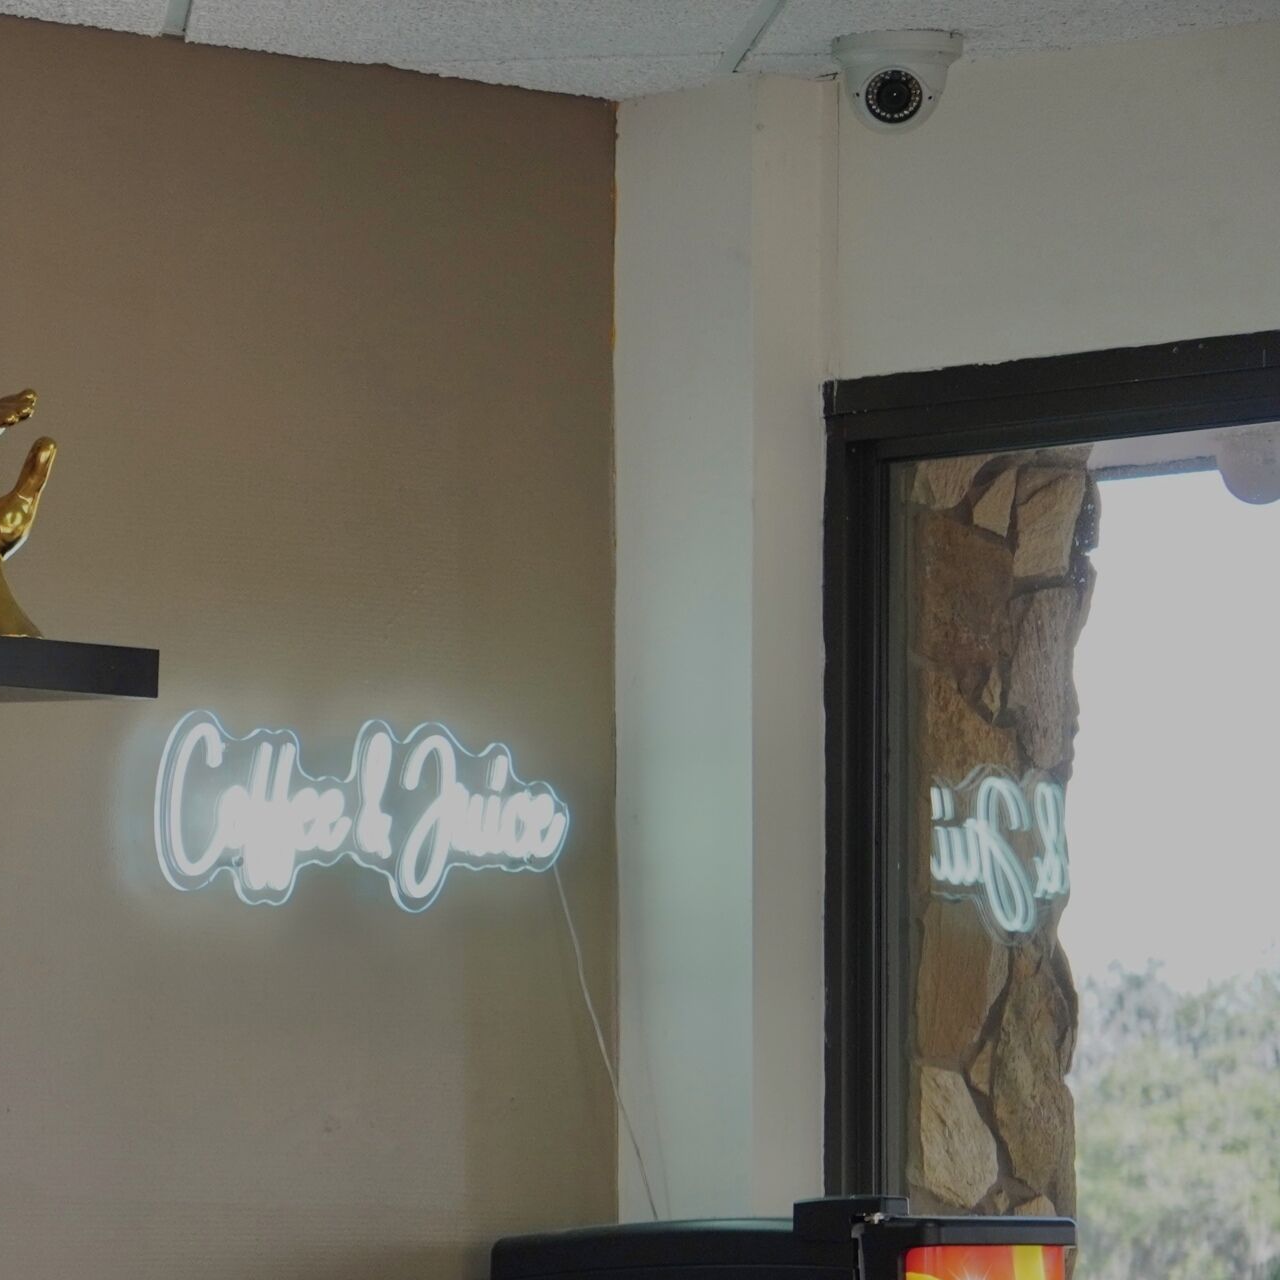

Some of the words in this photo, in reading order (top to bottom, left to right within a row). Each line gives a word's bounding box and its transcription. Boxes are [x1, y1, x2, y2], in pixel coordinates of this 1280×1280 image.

[170, 722, 351, 890] Coffee
[356, 731, 393, 858] &
[401, 734, 566, 898] Juice
